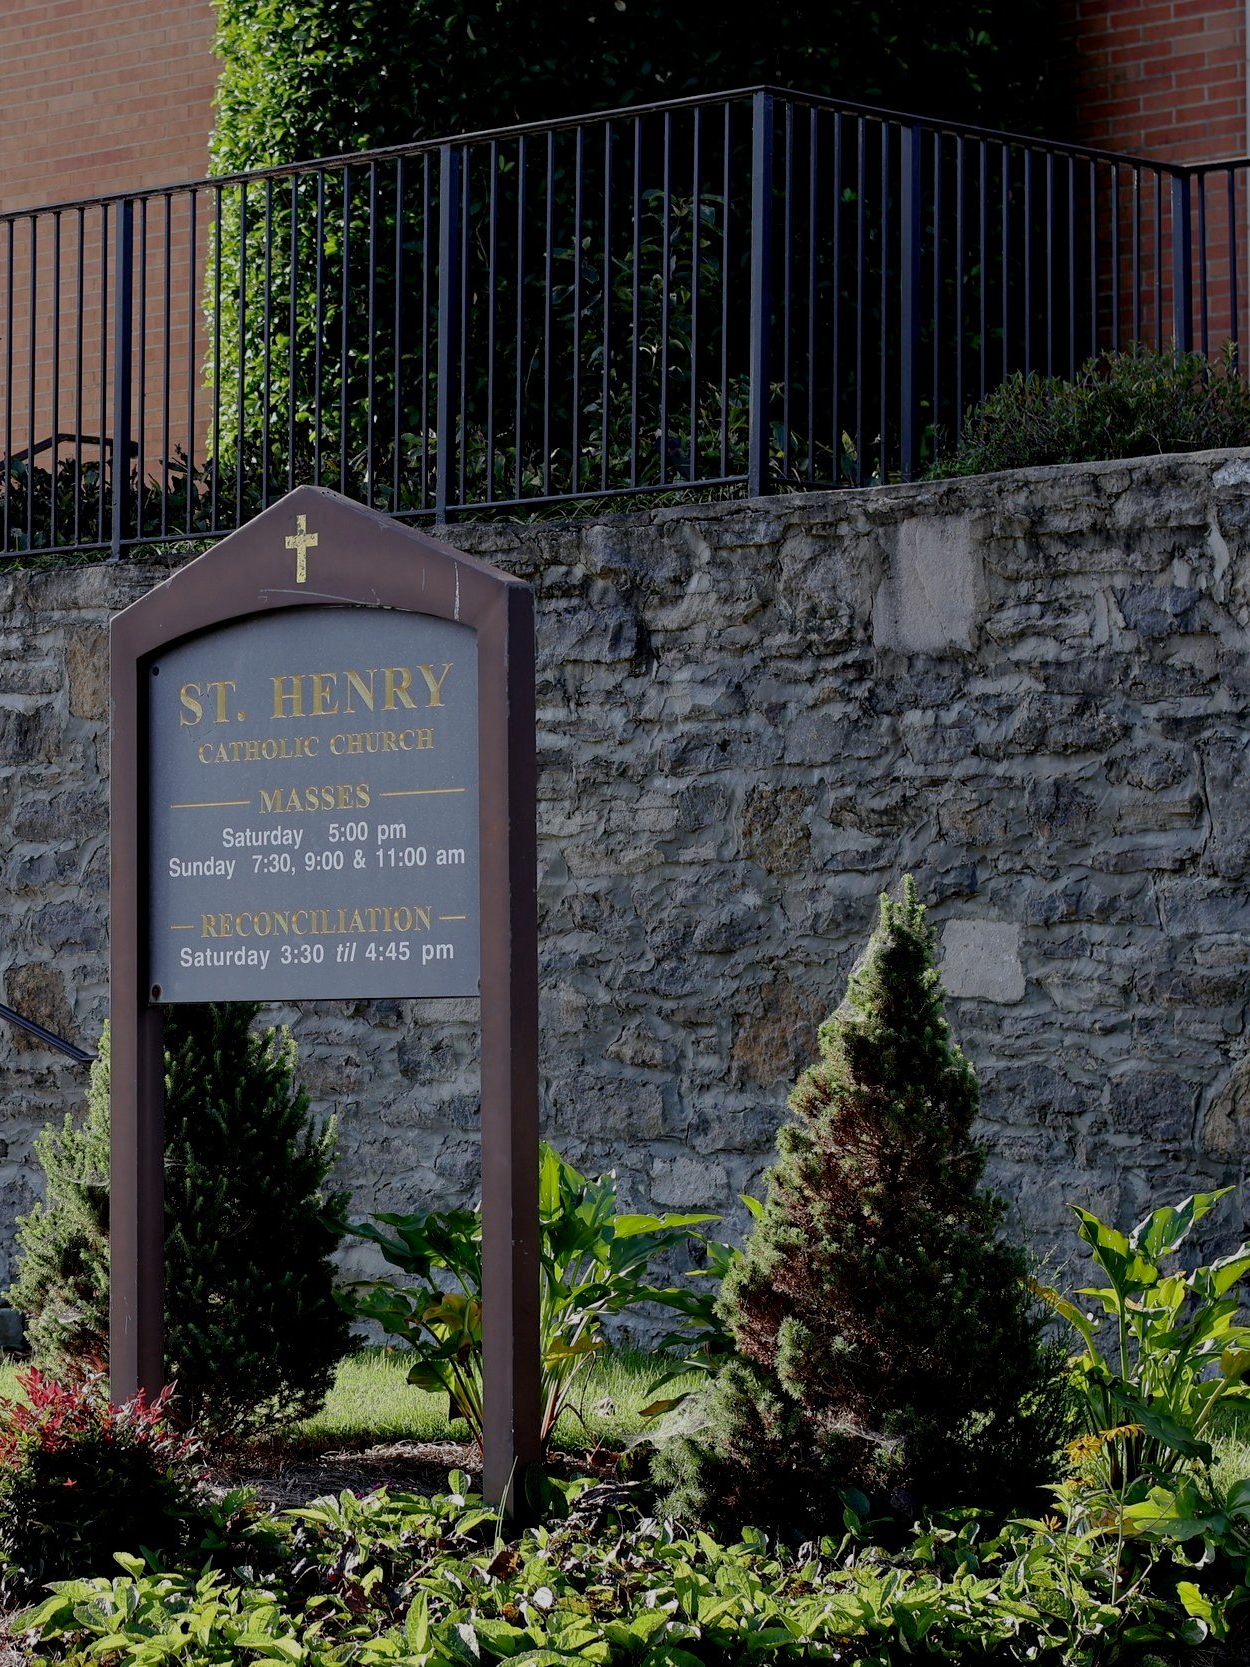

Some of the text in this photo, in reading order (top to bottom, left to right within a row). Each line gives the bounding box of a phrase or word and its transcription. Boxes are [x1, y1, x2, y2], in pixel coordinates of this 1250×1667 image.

[179, 662, 454, 727] ST. HENRY
[198, 728, 435, 764] CATHOLIC CHURCH
[258, 783, 372, 814] MASSES
[222, 821, 407, 850] Saturday 5:00 pm
[168, 847, 466, 880] Sunday 7:30, 9:00 & 11:00 am
[200, 905, 433, 939] RECONCILIATION
[179, 941, 455, 970] Saturday 3:30 til 4:45 pm
